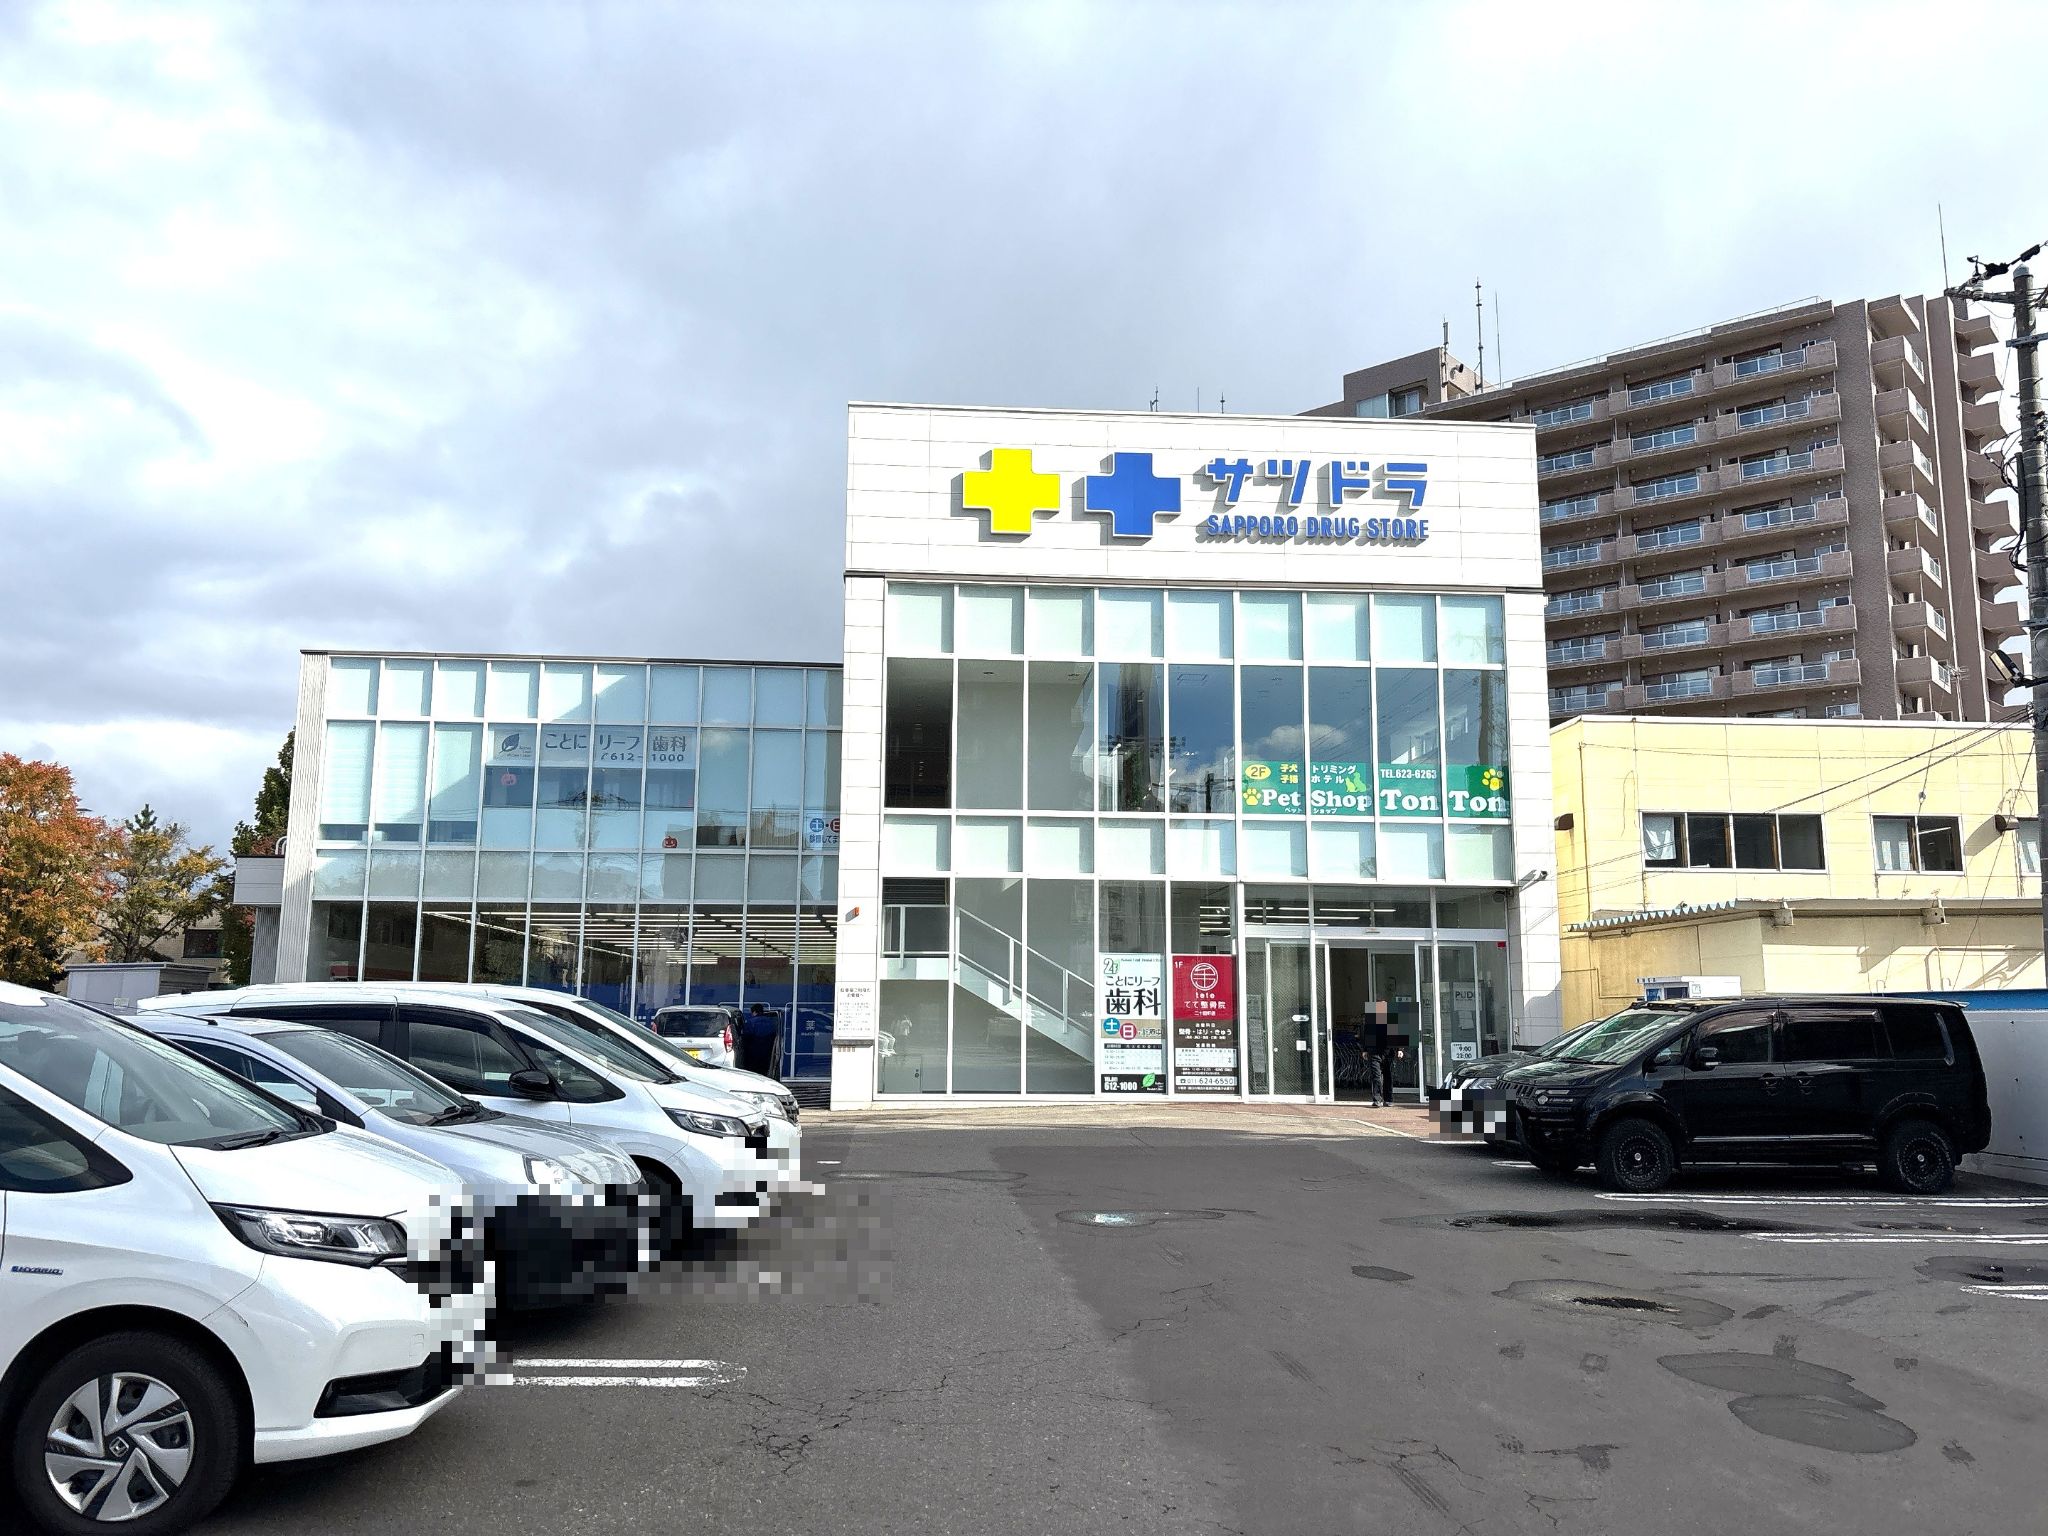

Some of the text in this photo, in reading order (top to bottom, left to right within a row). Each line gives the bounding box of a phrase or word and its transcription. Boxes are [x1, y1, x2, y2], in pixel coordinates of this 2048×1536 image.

[1207, 458, 1428, 509] サツドラ
[1207, 515, 1430, 541] SAPPORO DRUG STORE
[1251, 767, 1266, 777] 2F
[1280, 764, 1298, 773] 子犬
[1312, 765, 1356, 774] トリミング
[1311, 775, 1344, 784] ホテル
[1261, 789, 1507, 812] Pet Shop Ton Ton
[1106, 975, 1160, 986] ことにリーフ
[1105, 988, 1161, 1016] 歯科
[1104, 1082, 1138, 1091] 612-1000
